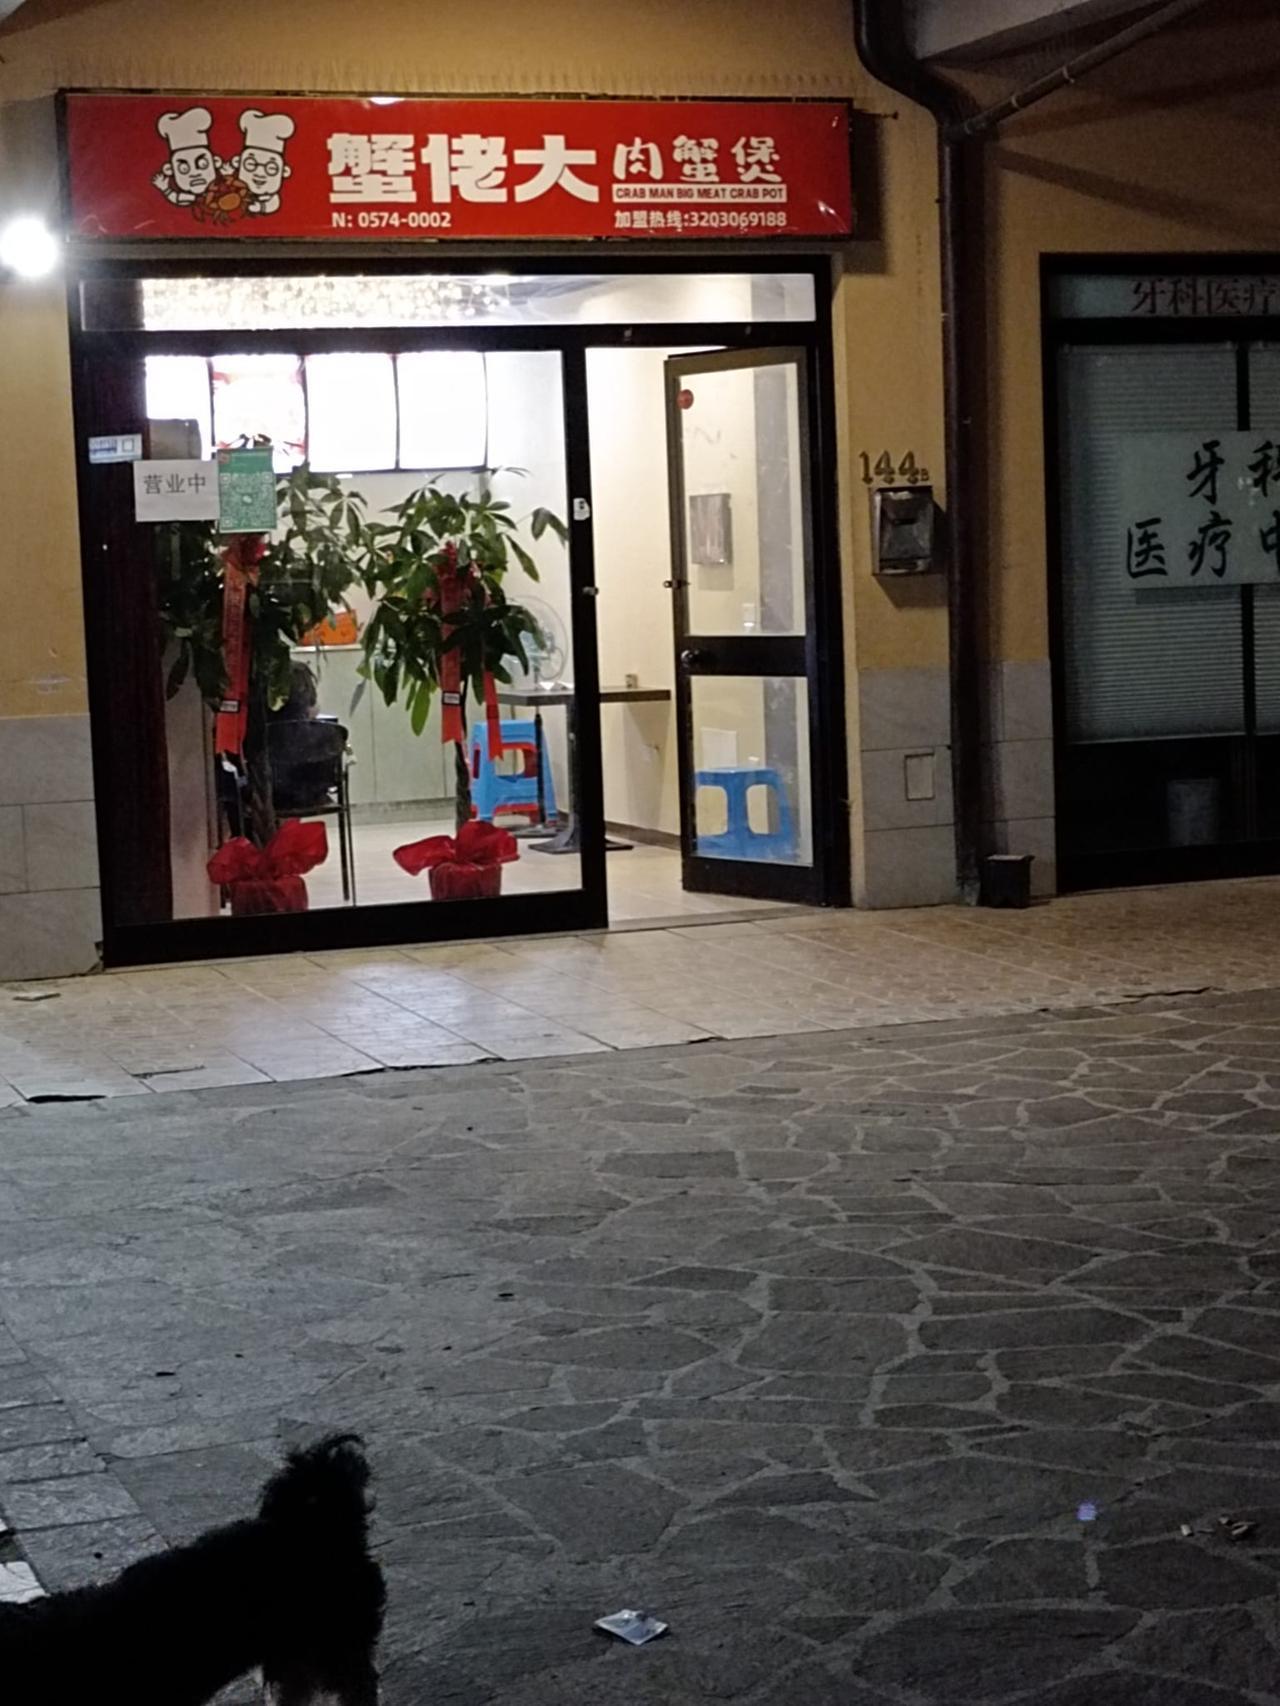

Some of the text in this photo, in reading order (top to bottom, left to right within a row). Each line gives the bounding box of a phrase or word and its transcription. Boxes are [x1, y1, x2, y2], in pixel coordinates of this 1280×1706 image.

[327, 133, 600, 204] 蟹佬大
[613, 134, 783, 183] 肉蟹煲
[616, 188, 783, 199] CRAB MAN BIG MEAT CRAB POT
[331, 212, 452, 228] N: 0574-0002
[143, 473, 206, 494] 营业中
